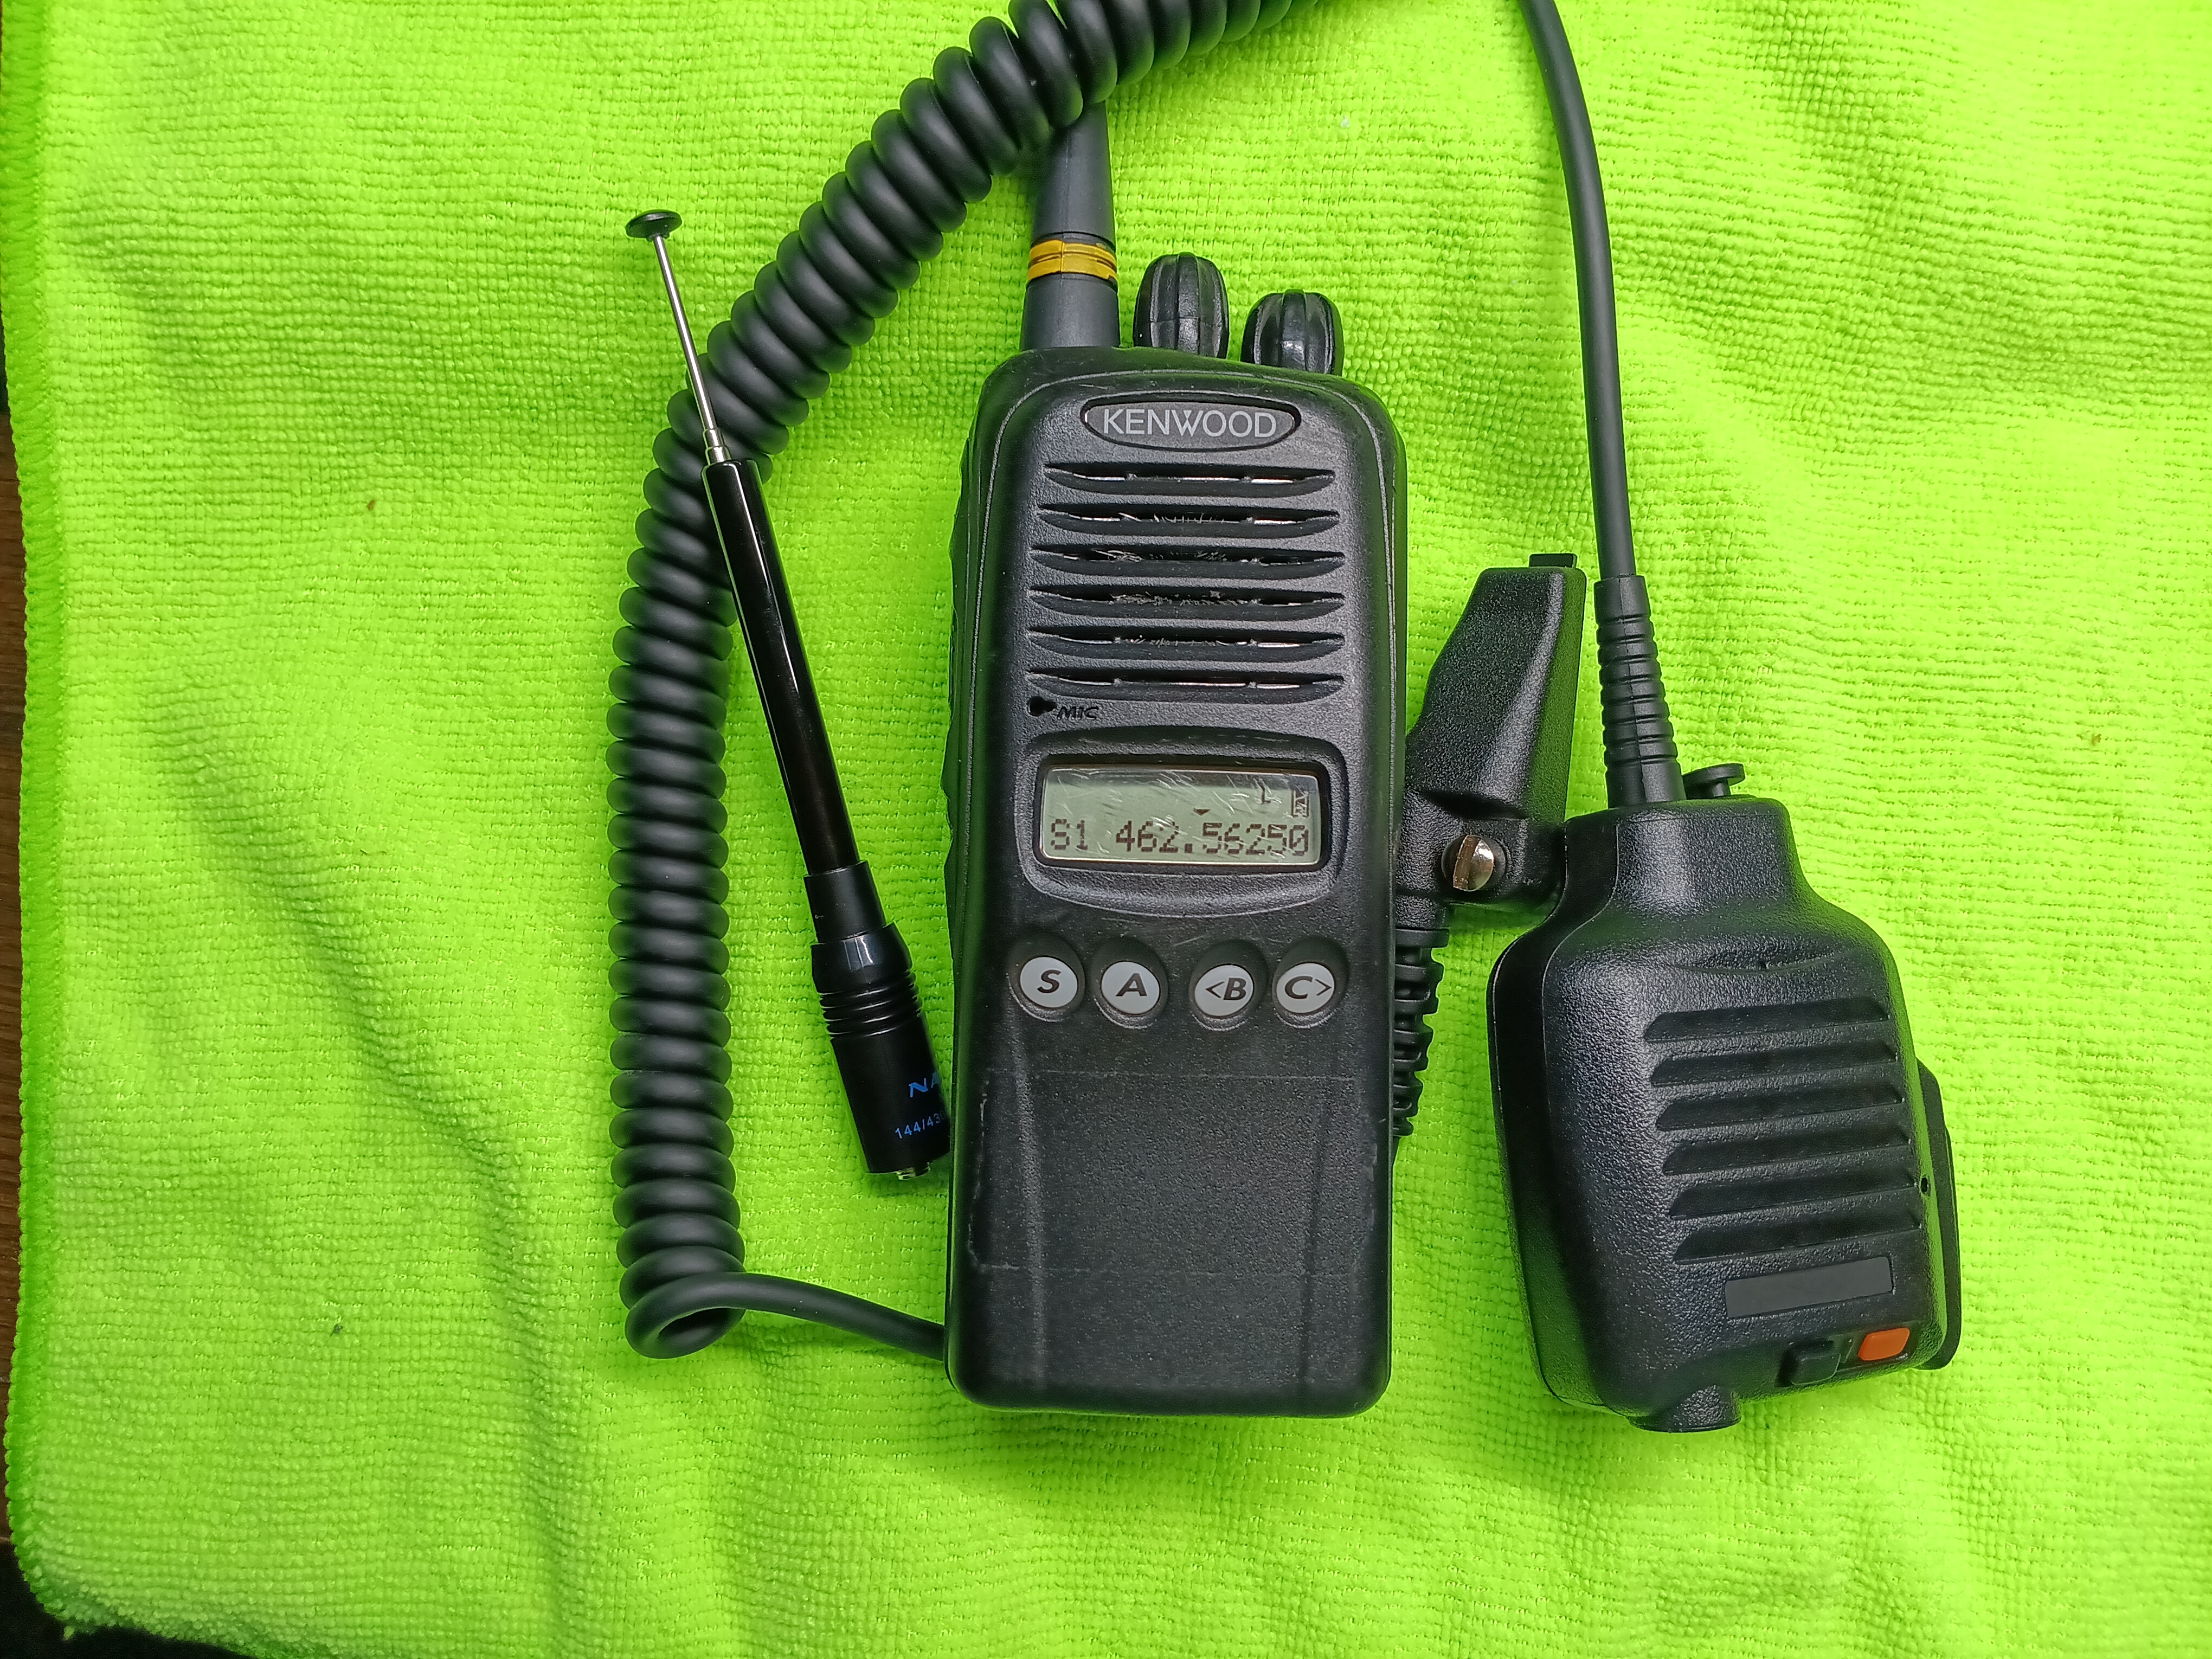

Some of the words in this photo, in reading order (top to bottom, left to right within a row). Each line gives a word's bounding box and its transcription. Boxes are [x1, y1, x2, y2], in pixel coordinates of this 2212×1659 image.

[1103, 409, 1277, 438] KENWOOD
[1058, 706, 1099, 721] MIC
[1051, 819, 1089, 851] S1
[1116, 820, 1309, 856] 462.56250
[1038, 970, 1060, 993] S
[1116, 974, 1147, 996] A
